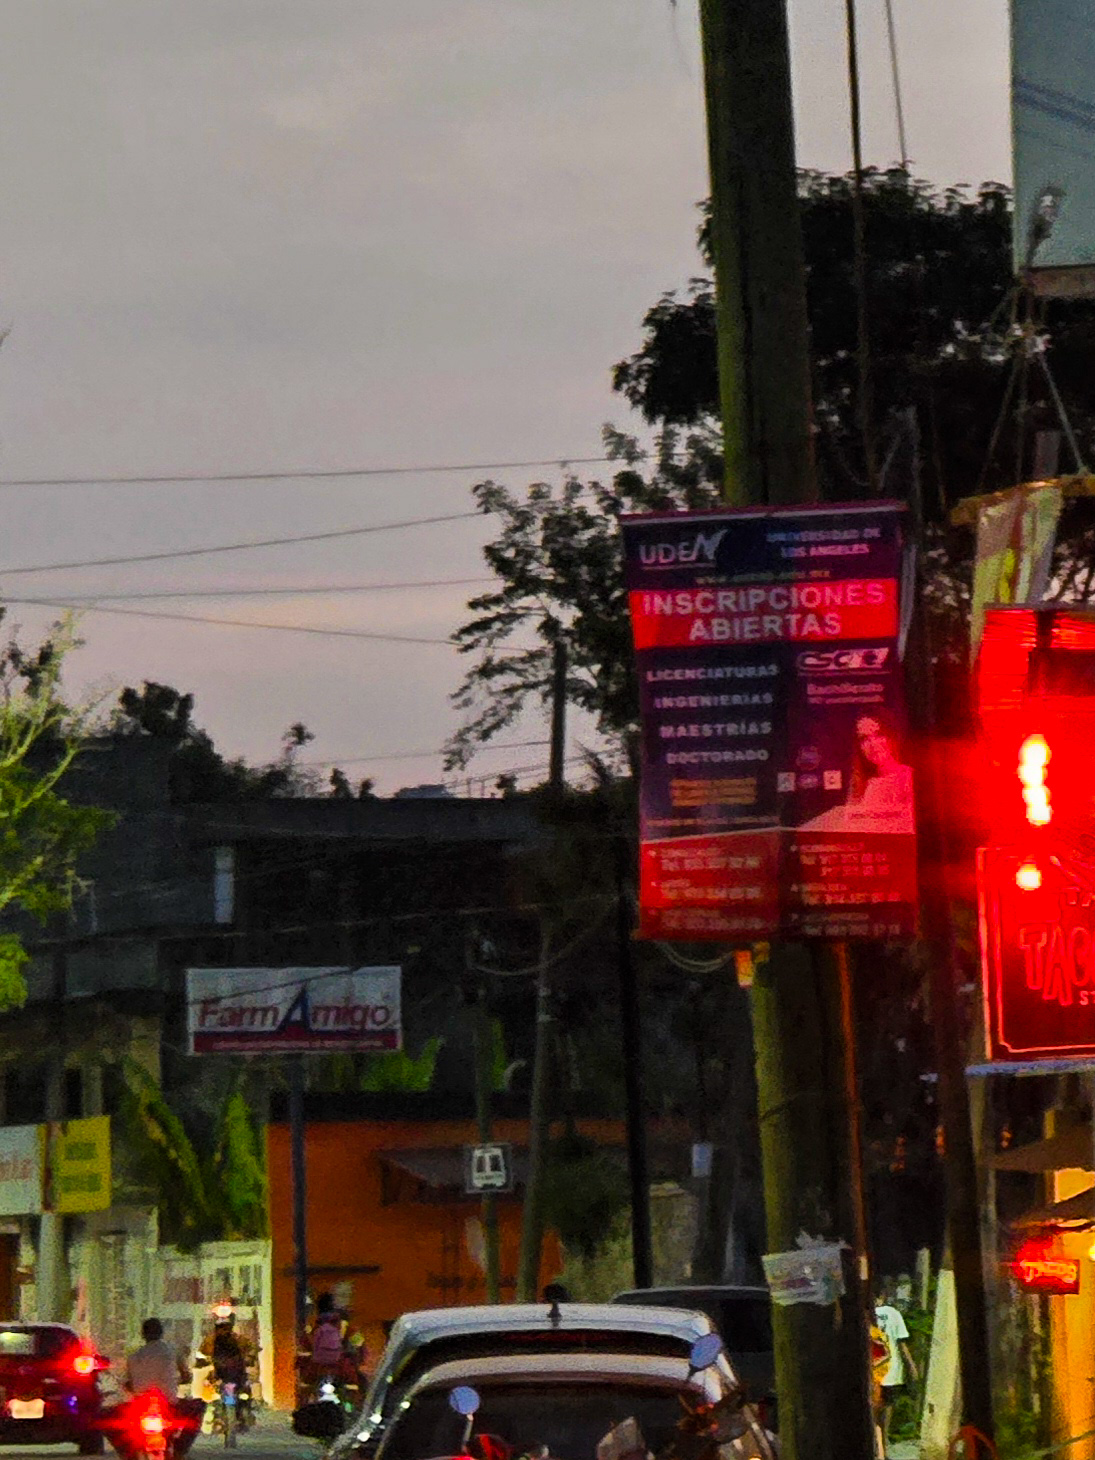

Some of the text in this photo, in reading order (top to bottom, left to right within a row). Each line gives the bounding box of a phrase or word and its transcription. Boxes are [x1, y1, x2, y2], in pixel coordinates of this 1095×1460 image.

[642, 583, 885, 616] INSCRIPCIONES
[688, 612, 842, 642] ABIERTAS
[646, 664, 779, 682] LICENCIATURAS
[665, 749, 770, 765] DOCTORADO
